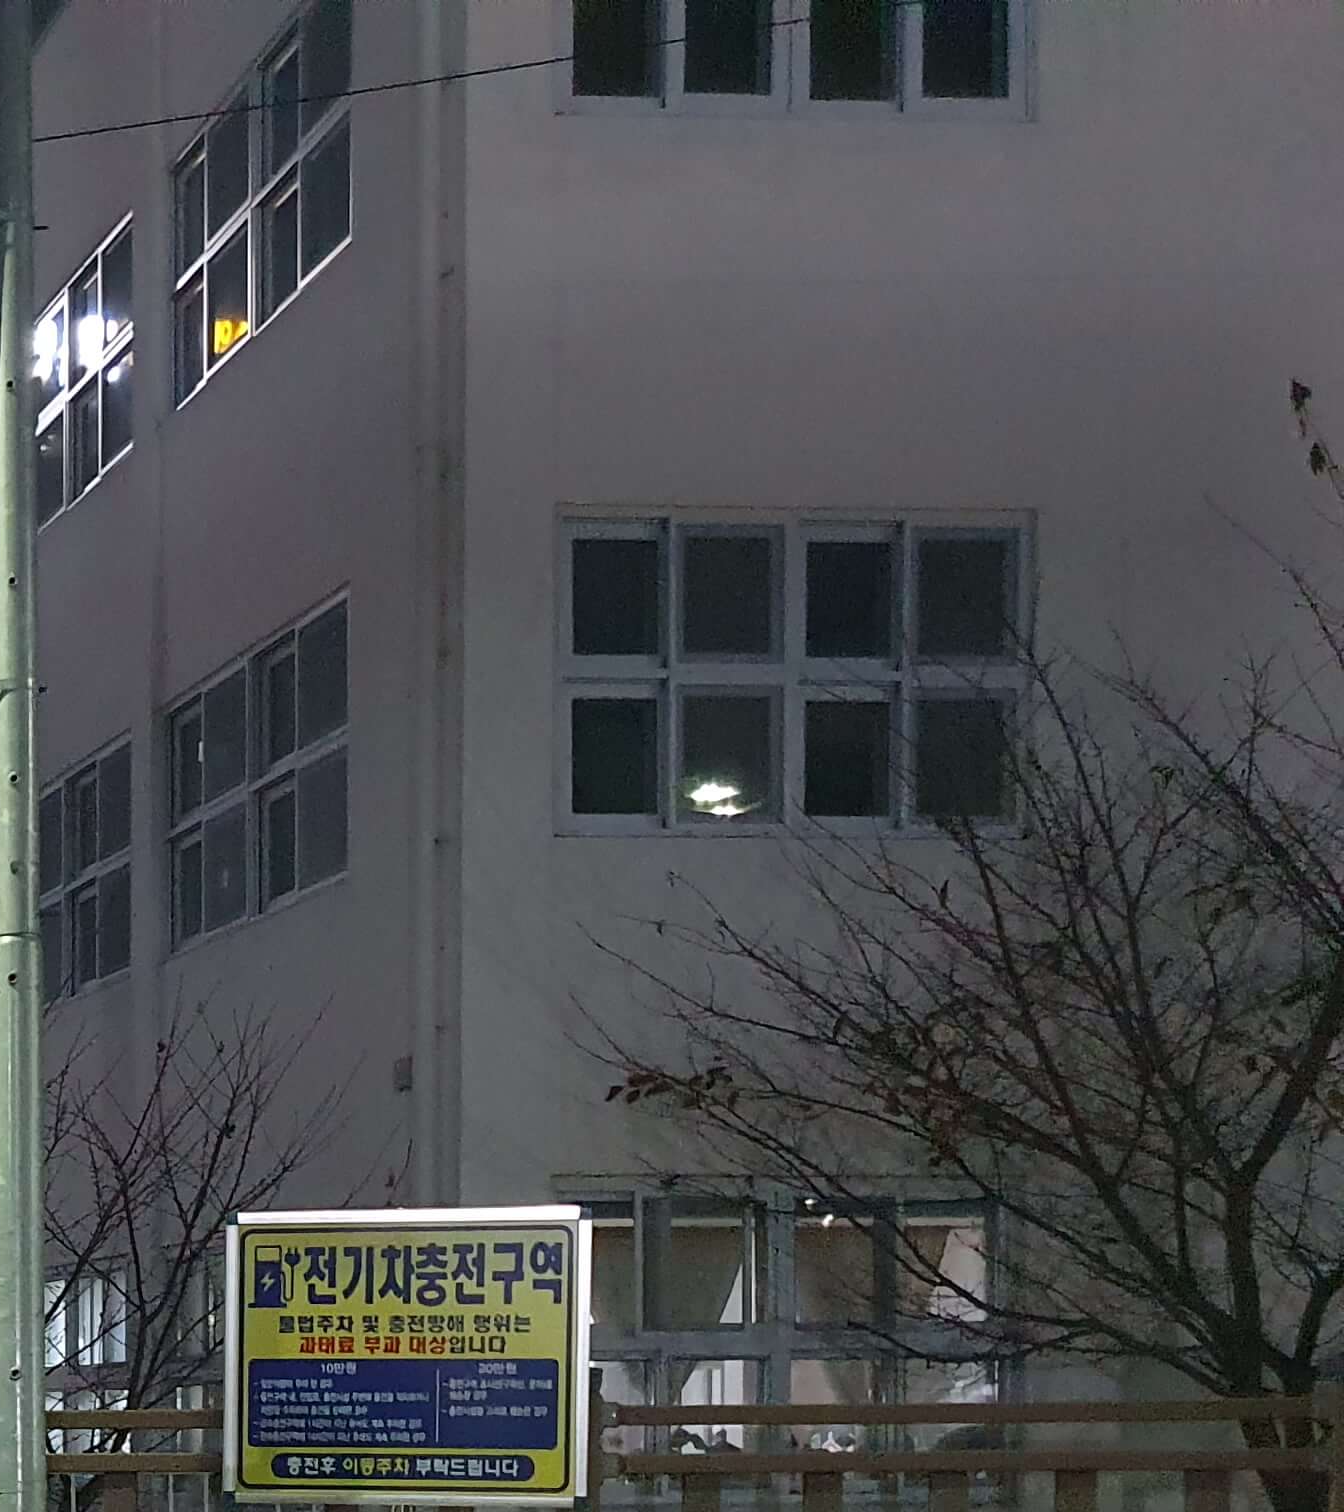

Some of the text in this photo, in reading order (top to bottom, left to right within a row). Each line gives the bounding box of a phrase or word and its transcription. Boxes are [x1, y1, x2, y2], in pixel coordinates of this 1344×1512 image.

[304, 1241, 564, 1307] 전기차충전구역
[362, 1315, 379, 1333] 및
[389, 1315, 466, 1334] 충전방해
[473, 1315, 532, 1334] 행위는
[299, 1336, 507, 1355] 과태료 부과 대상입니다
[320, 1362, 357, 1376] 10만원
[287, 1456, 337, 1476] 충전후
[342, 1457, 410, 1477] 이동주차
